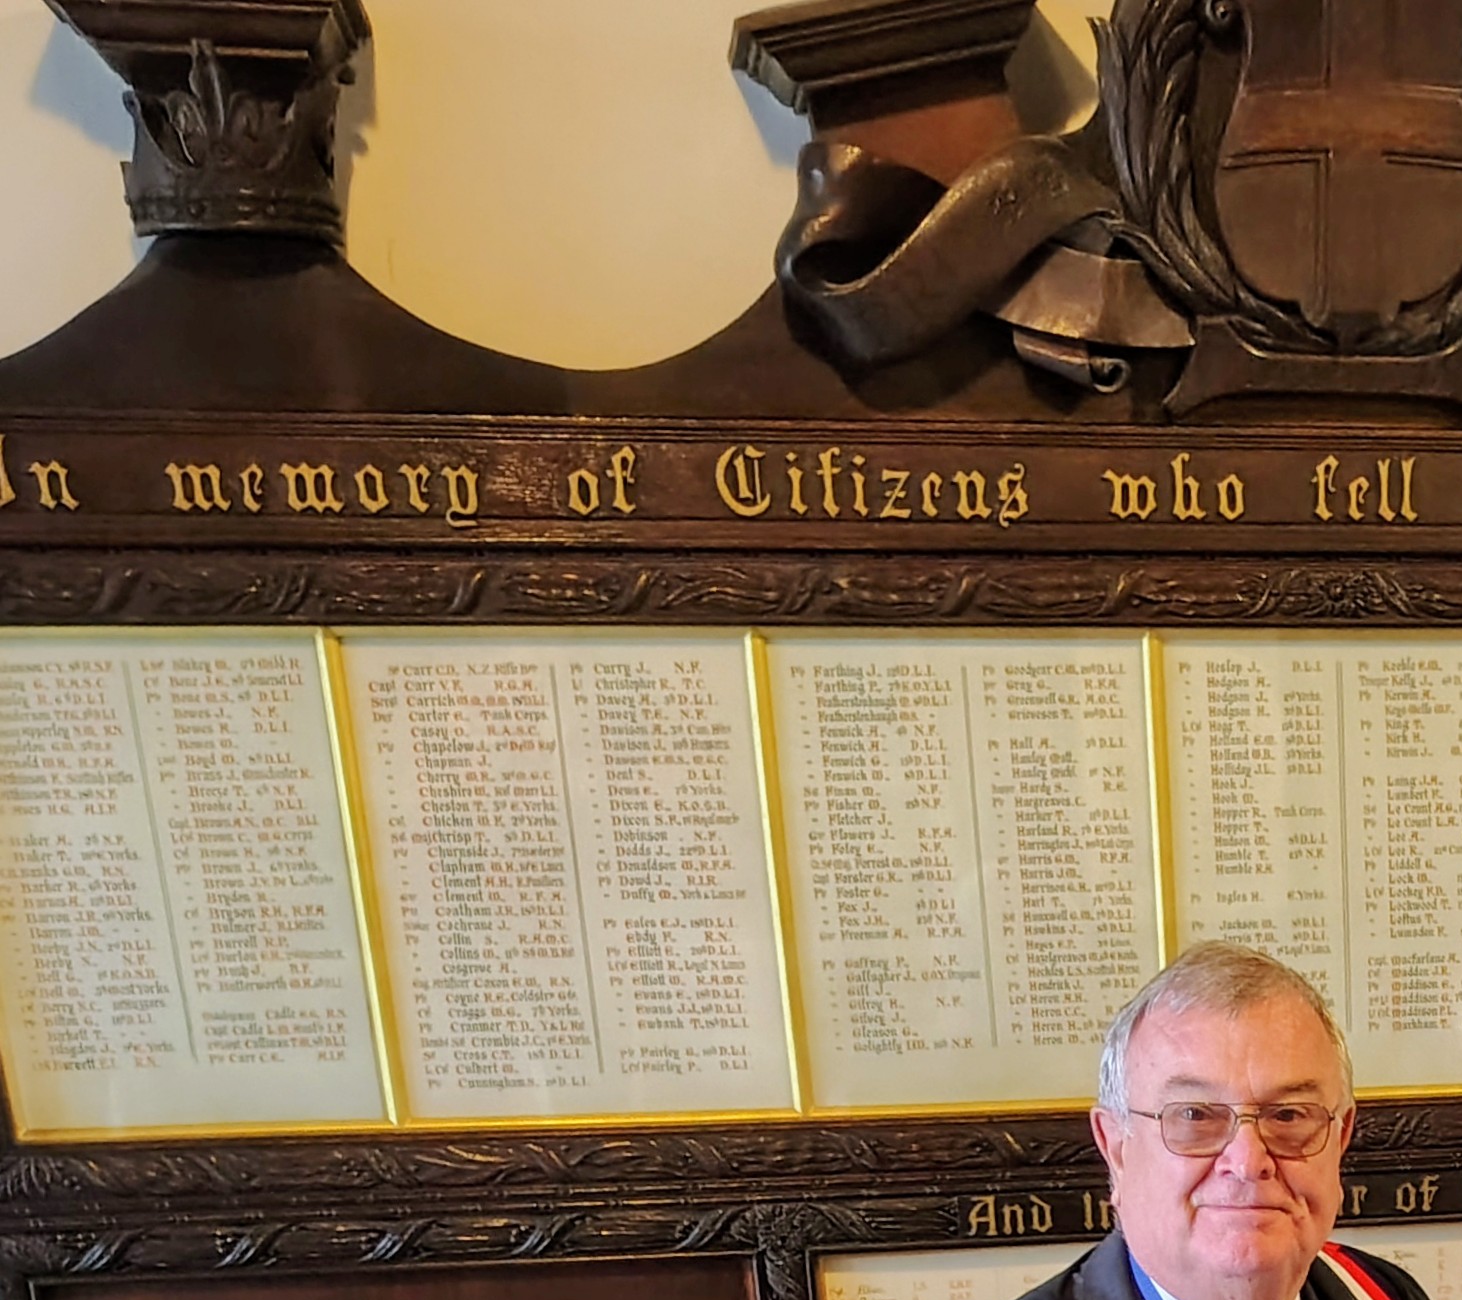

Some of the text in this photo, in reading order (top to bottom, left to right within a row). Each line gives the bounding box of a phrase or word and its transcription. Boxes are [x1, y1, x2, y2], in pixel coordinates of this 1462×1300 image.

[165, 460, 480, 528] memory
[567, 445, 637, 516] of
[715, 445, 1028, 528] Citizens
[1102, 452, 1245, 521] who
[1311, 454, 1419, 521] fell
[967, 1195, 1053, 1236] And
[1396, 1174, 1439, 1211] of
